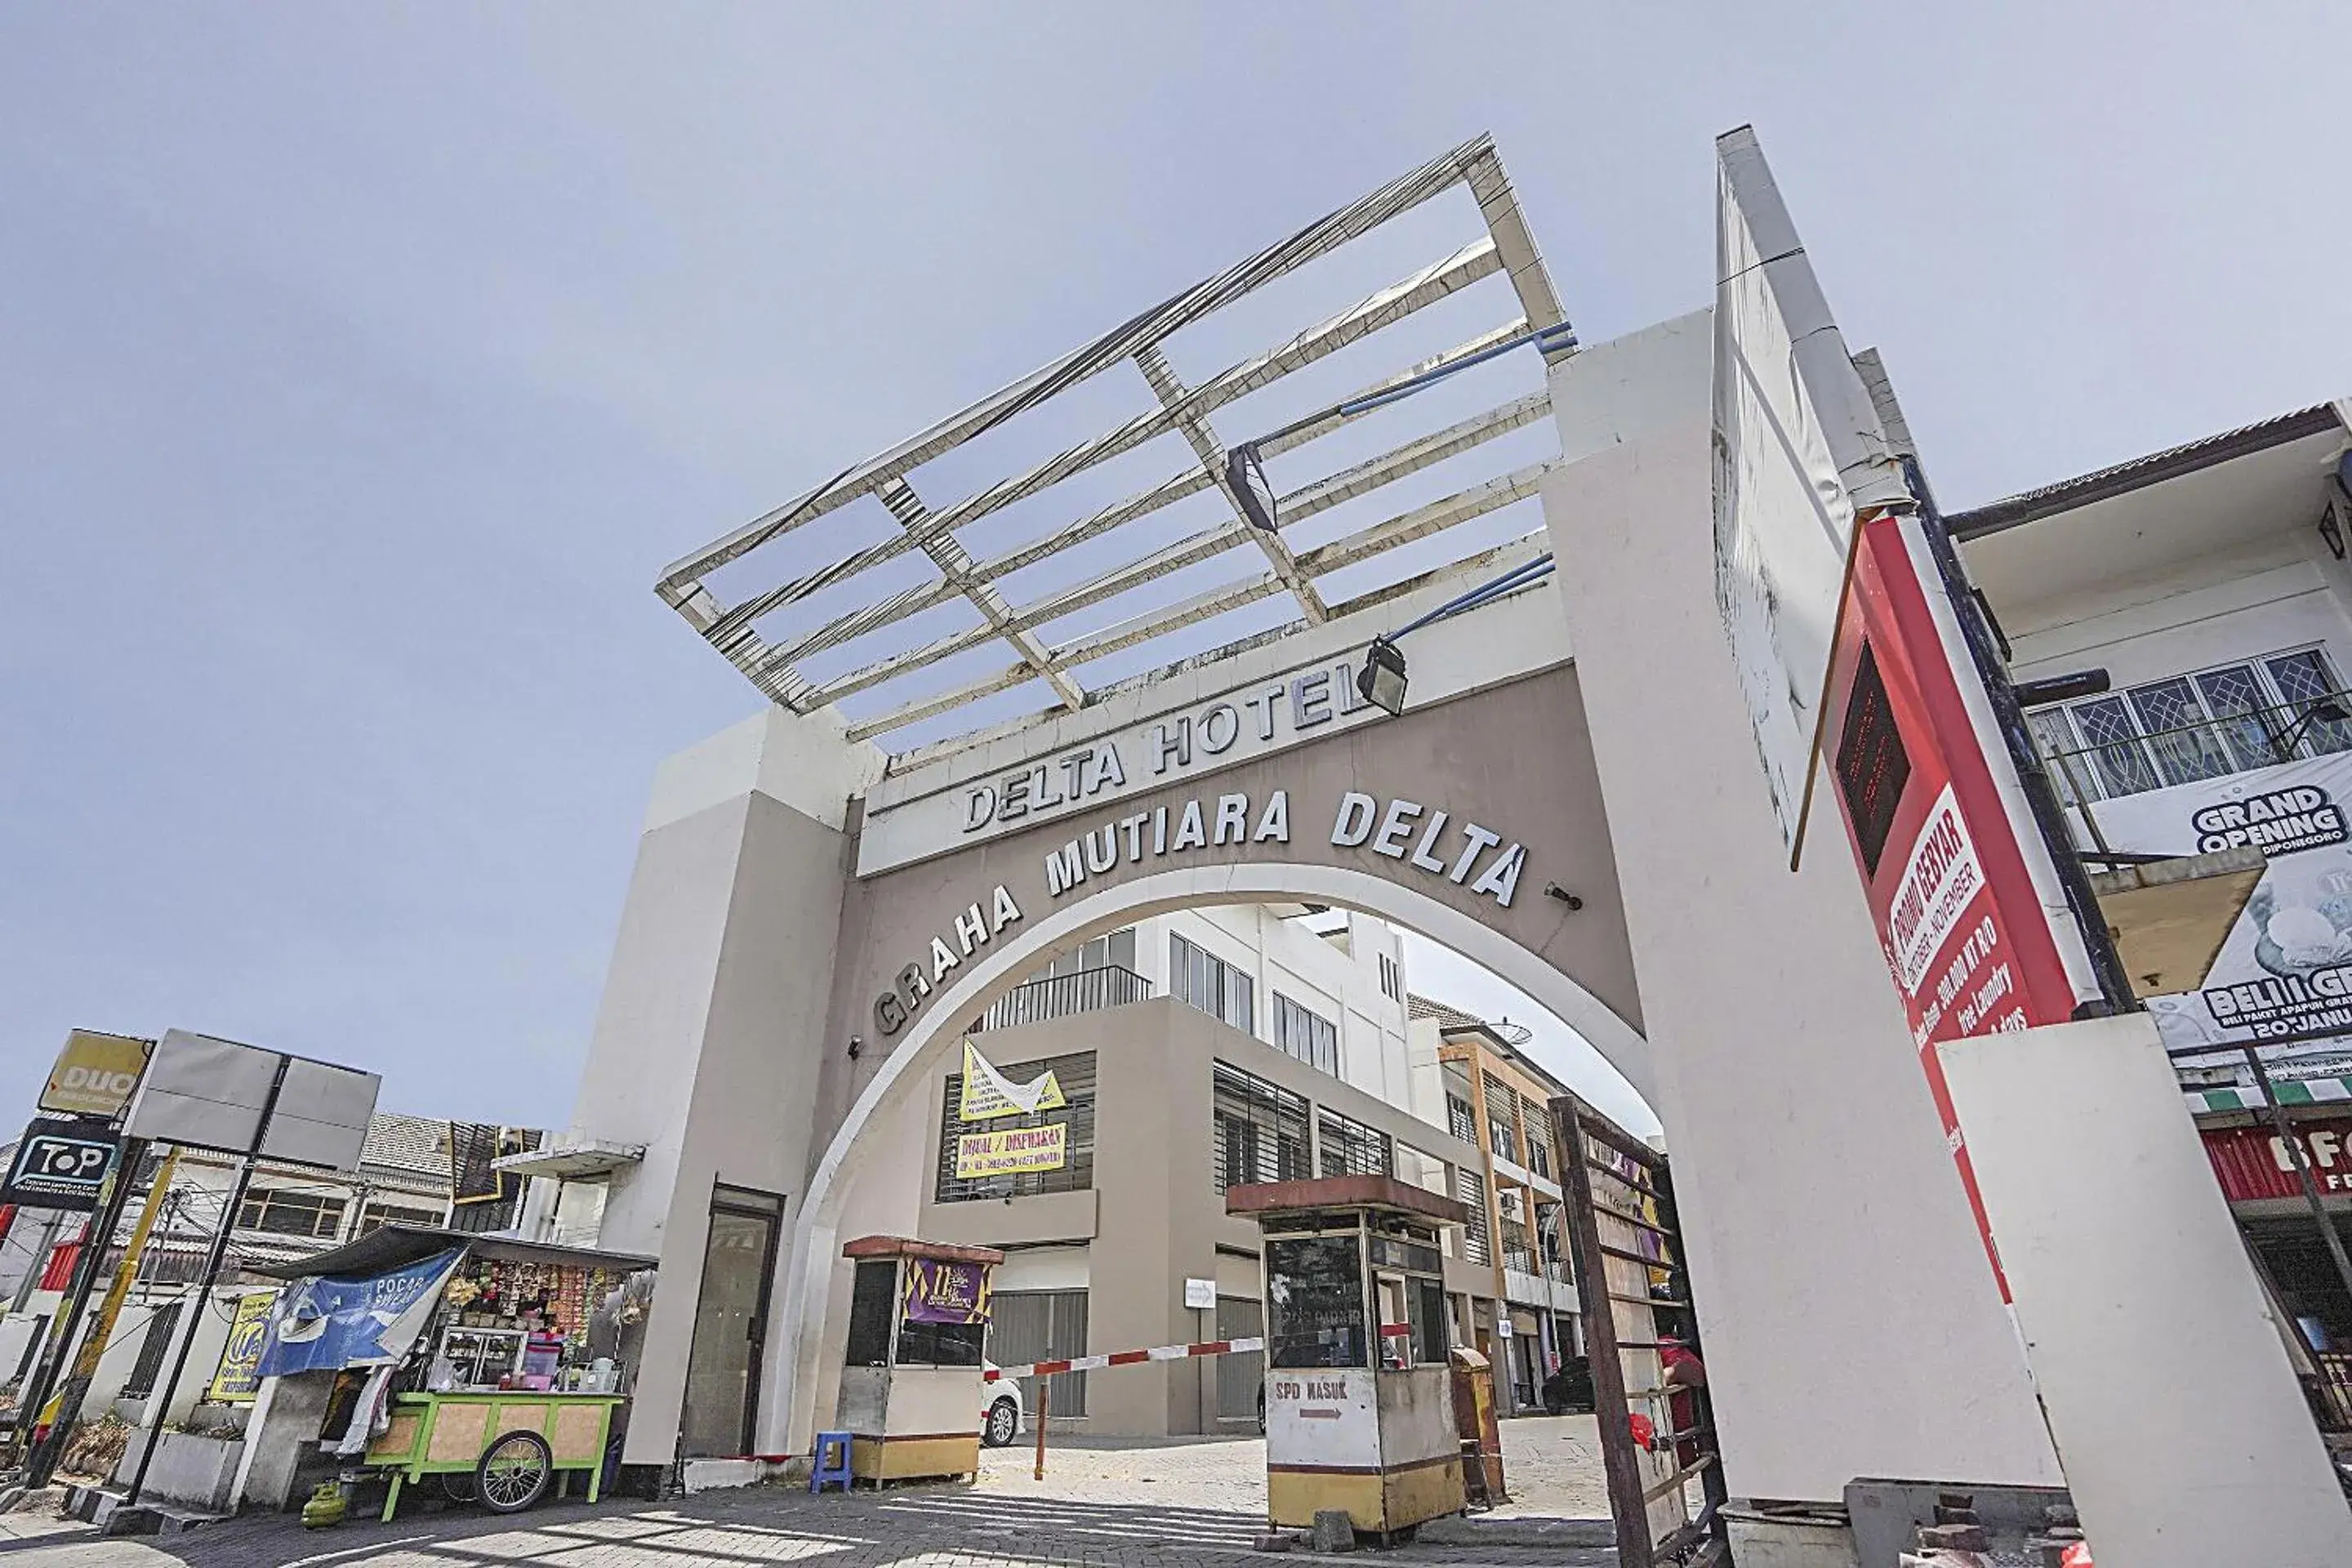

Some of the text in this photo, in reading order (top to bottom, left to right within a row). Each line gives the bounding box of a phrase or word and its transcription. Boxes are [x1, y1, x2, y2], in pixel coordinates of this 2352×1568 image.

[964, 662, 1374, 834] DELTA HOTEL
[2198, 787, 2322, 832] GRAND
[2203, 808, 2341, 853] OPENING
[1916, 808, 1963, 904] GEBYAR
[873, 791, 1530, 1036] GRAHA MUTIARA DELTA
[1931, 862, 1976, 937] NOVEMBER
[1971, 962, 2013, 1018] Laundry
[2207, 980, 2285, 1017] BELI
[2245, 1009, 2278, 1022] PAKET
[2281, 1000, 2324, 1016] APAPUN
[63, 1066, 137, 1095] DUO
[40, 1143, 103, 1176] TOP
[376, 1277, 425, 1297] POCAR
[1276, 1381, 1348, 1400] SPD MASUK
